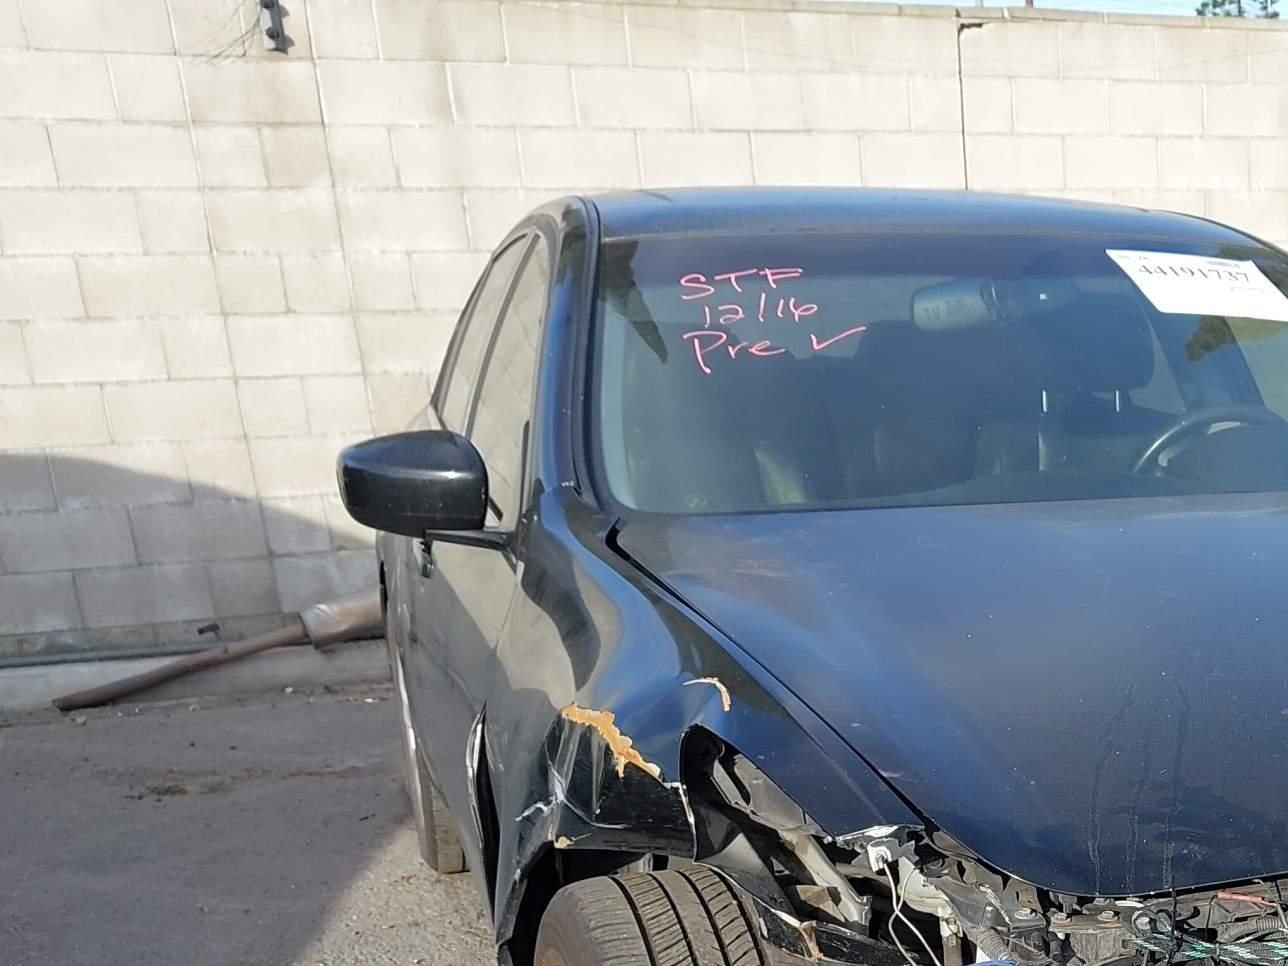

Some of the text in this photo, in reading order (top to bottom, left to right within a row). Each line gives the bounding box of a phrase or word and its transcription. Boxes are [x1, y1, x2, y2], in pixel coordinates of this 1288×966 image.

[680, 268, 803, 300] STF
[1138, 264, 1250, 282] 44191737
[704, 292, 818, 328] 12/16
[682, 330, 786, 374] Pre
